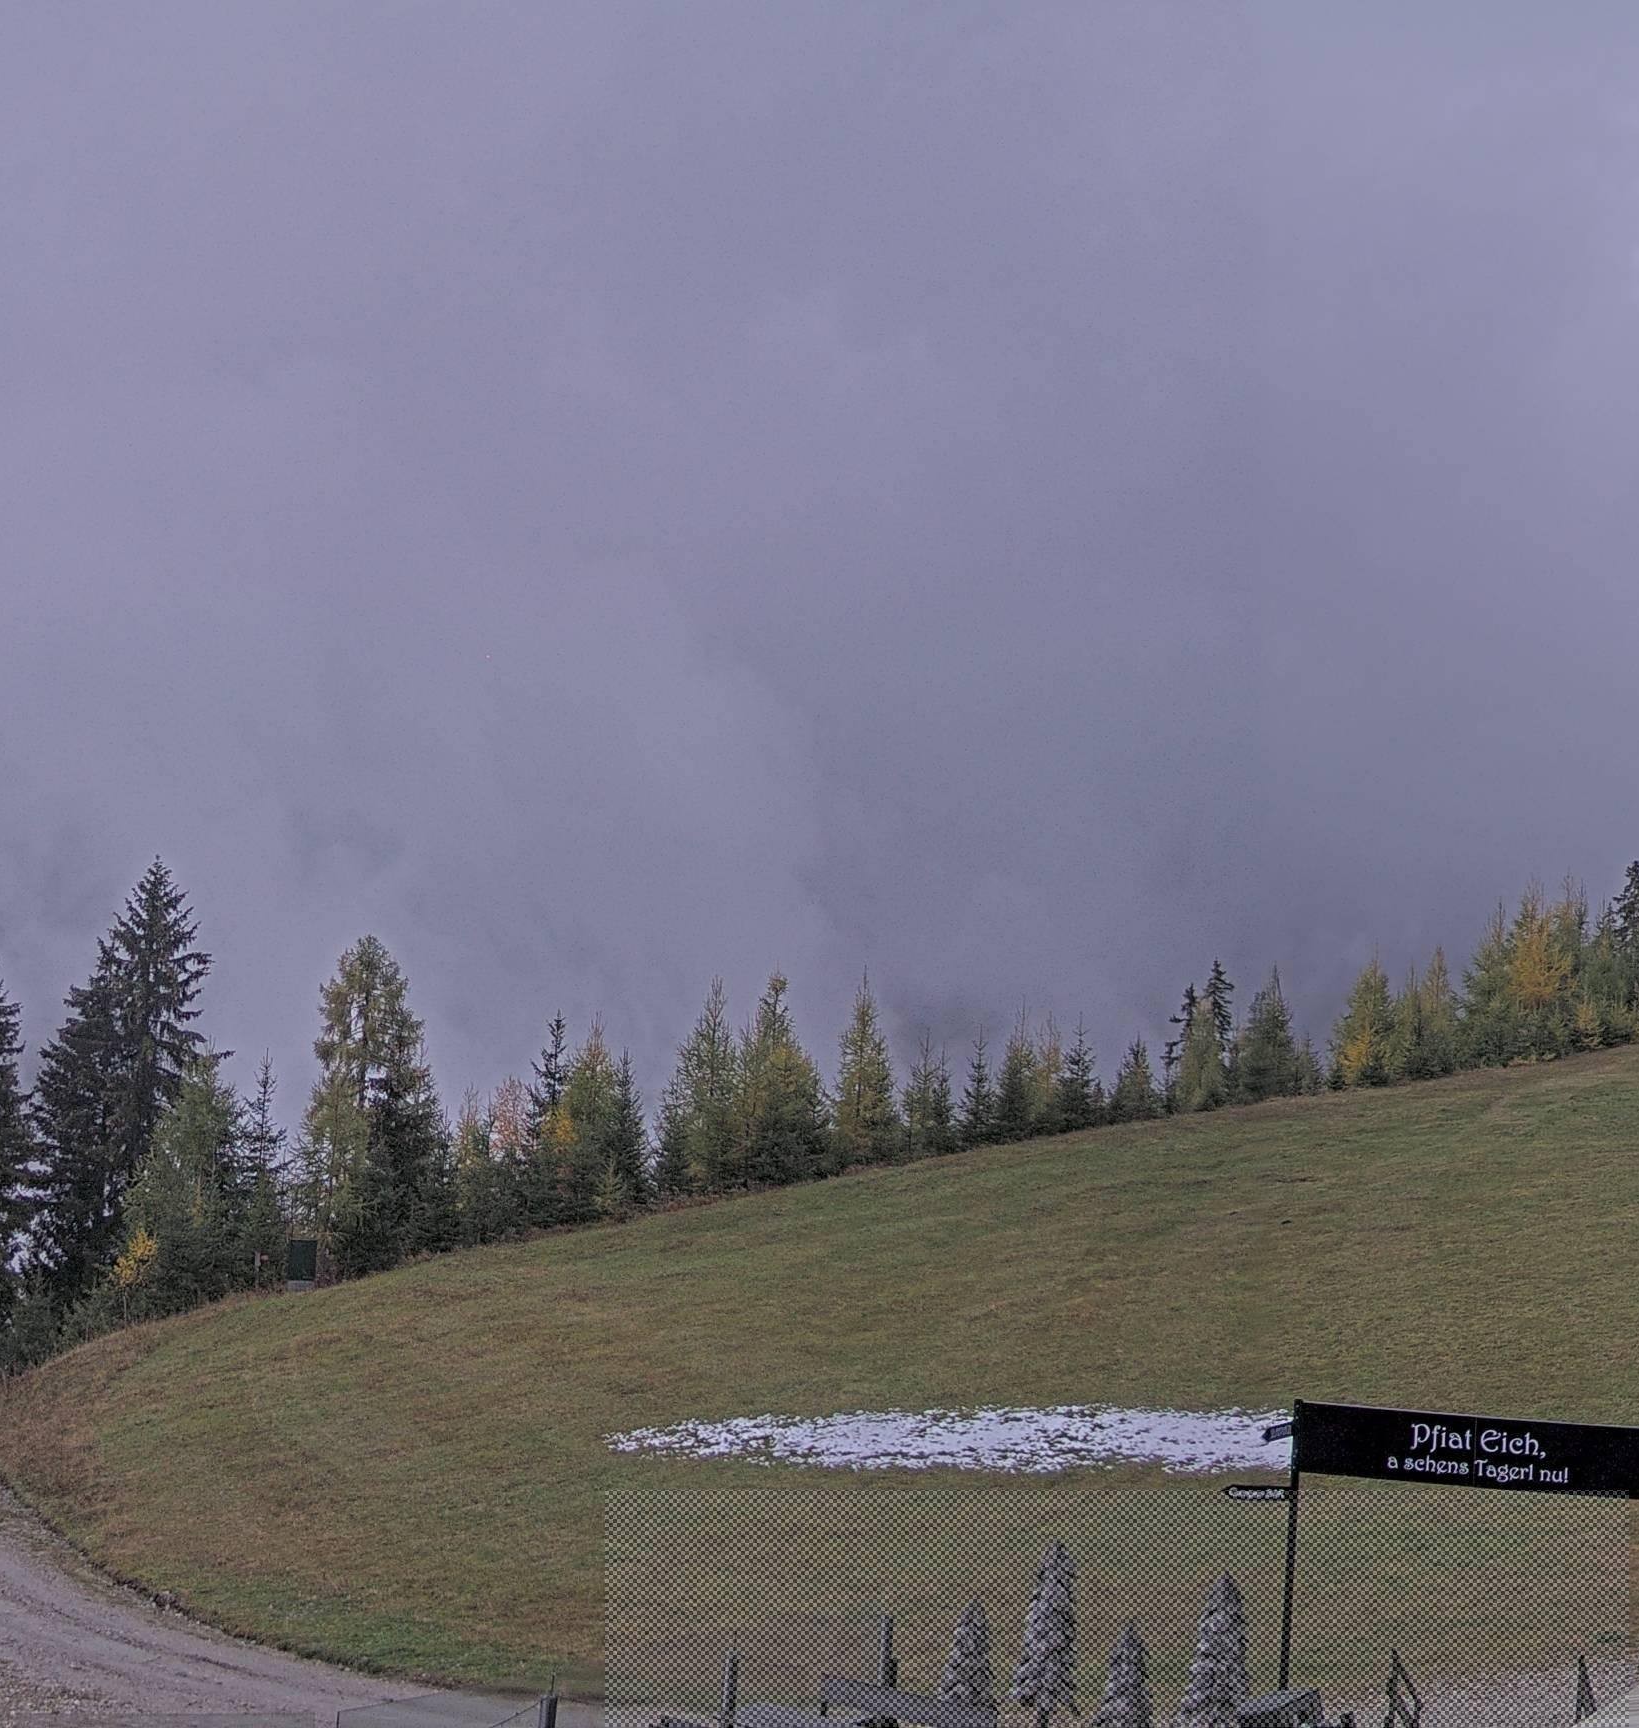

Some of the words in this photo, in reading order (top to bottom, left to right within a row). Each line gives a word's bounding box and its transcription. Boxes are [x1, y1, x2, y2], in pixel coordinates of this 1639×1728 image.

[1410, 1423, 1472, 1453] Pfiat
[1480, 1429, 1547, 1460] Eich,
[1387, 1456, 1399, 1469] a
[1403, 1455, 1470, 1475] schens
[1474, 1459, 1534, 1483] Tagerl
[1539, 1467, 1570, 1484] nu!
